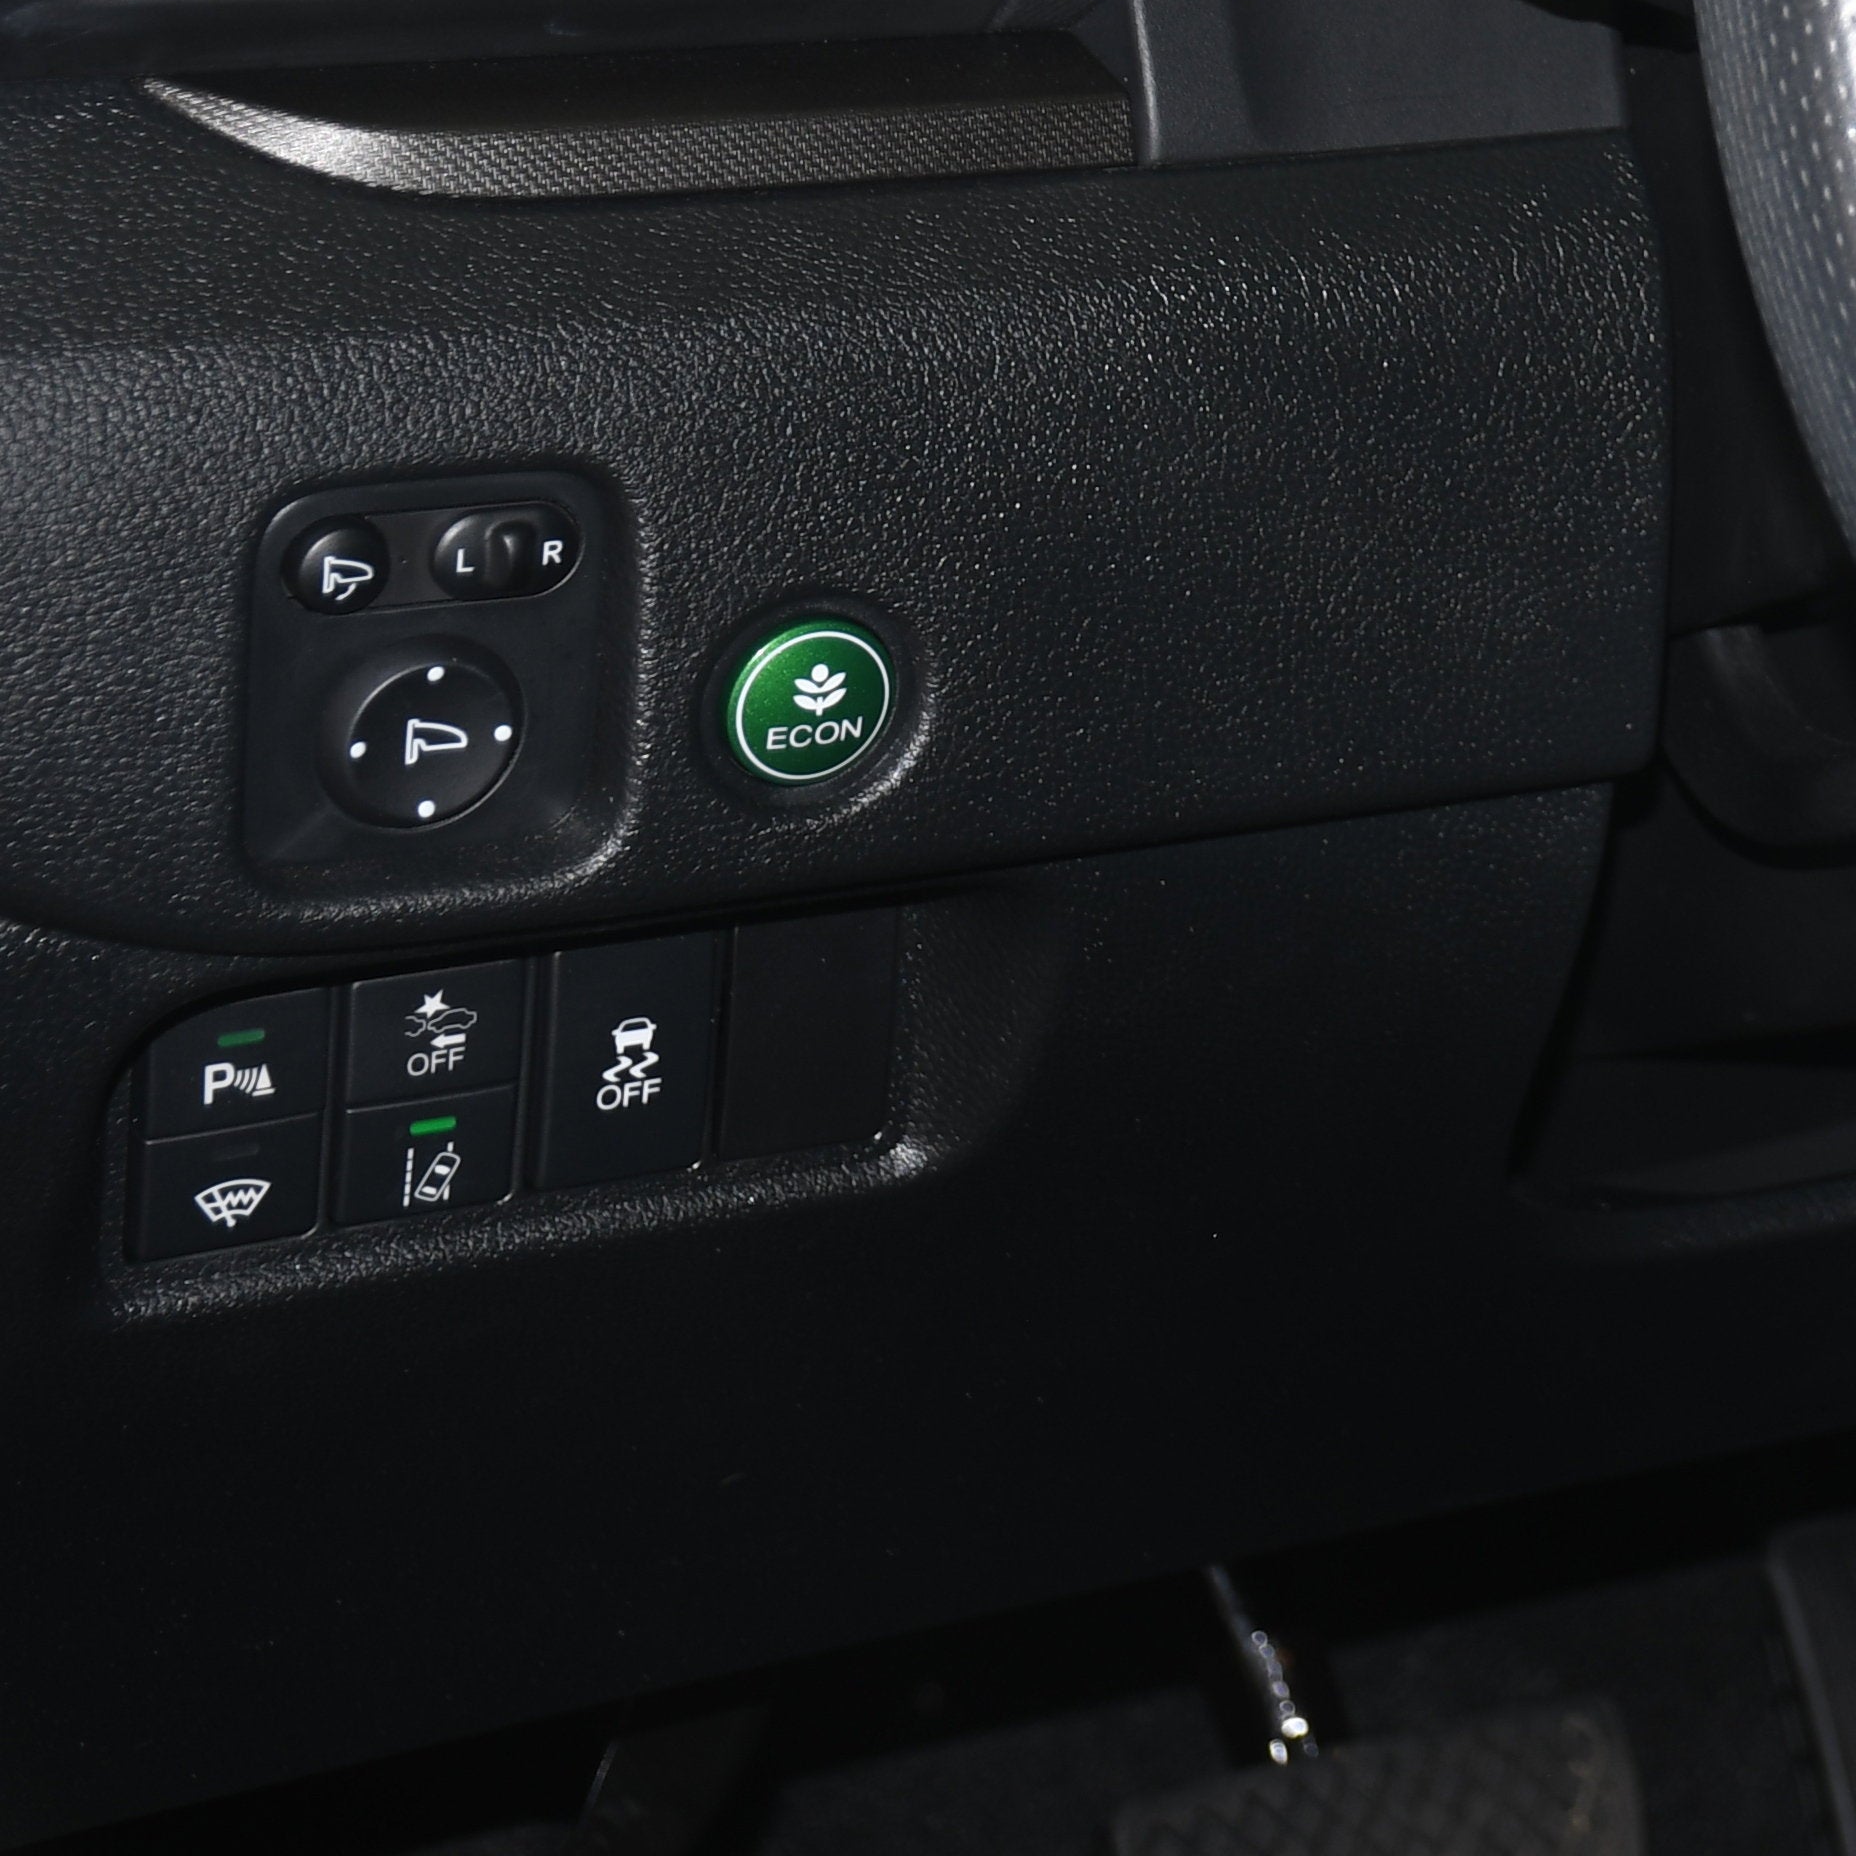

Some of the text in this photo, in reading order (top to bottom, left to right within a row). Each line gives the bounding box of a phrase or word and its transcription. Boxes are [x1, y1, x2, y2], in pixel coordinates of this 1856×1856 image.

[455, 548, 475, 574] L
[542, 539, 563, 566] R
[765, 716, 864, 752] ECON
[406, 1046, 466, 1078] OFF
[203, 1061, 233, 1106] P
[596, 1078, 663, 1111] OFF
